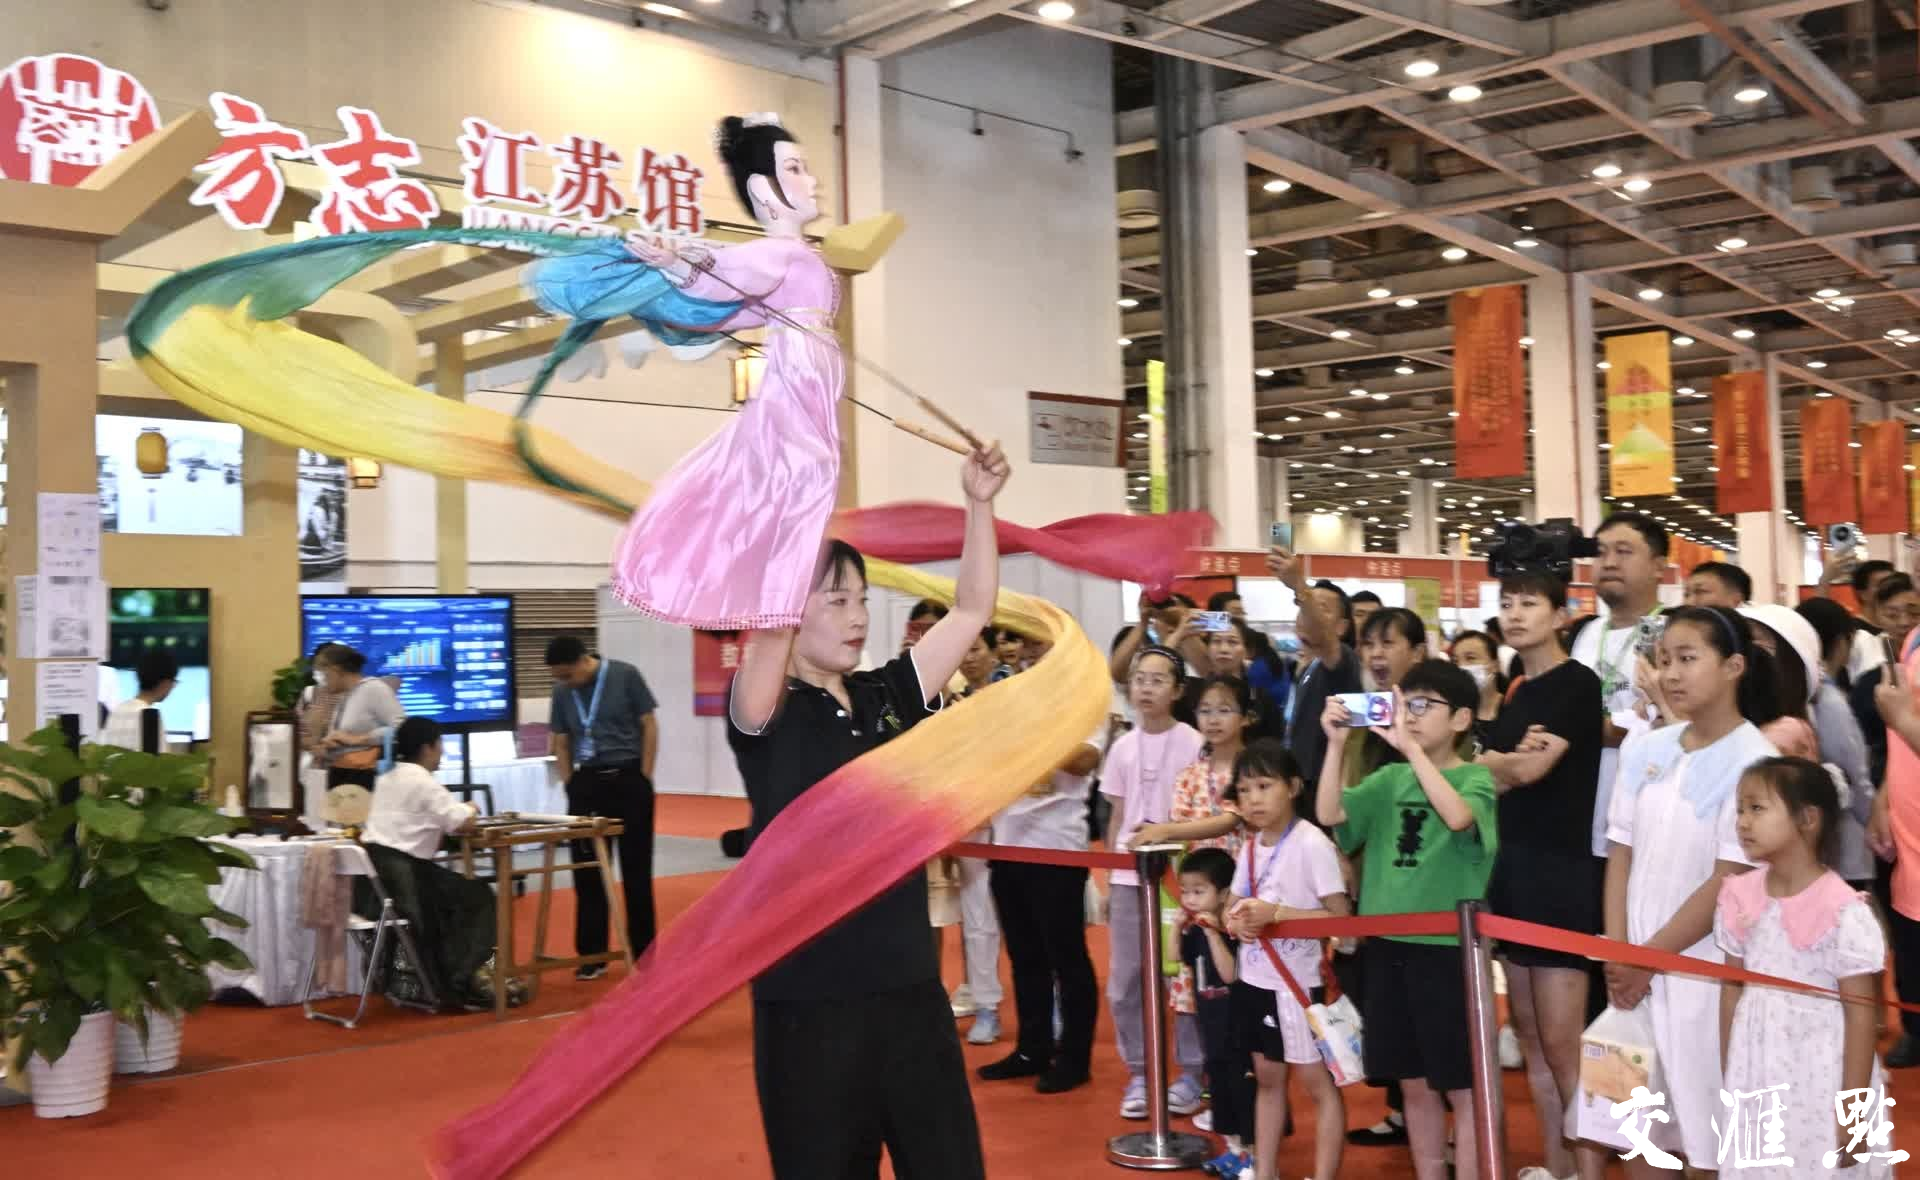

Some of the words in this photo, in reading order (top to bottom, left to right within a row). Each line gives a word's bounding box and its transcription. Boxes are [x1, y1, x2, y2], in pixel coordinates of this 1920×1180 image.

[191, 94, 439, 236] 方志
[461, 119, 706, 235] 江苏馆
